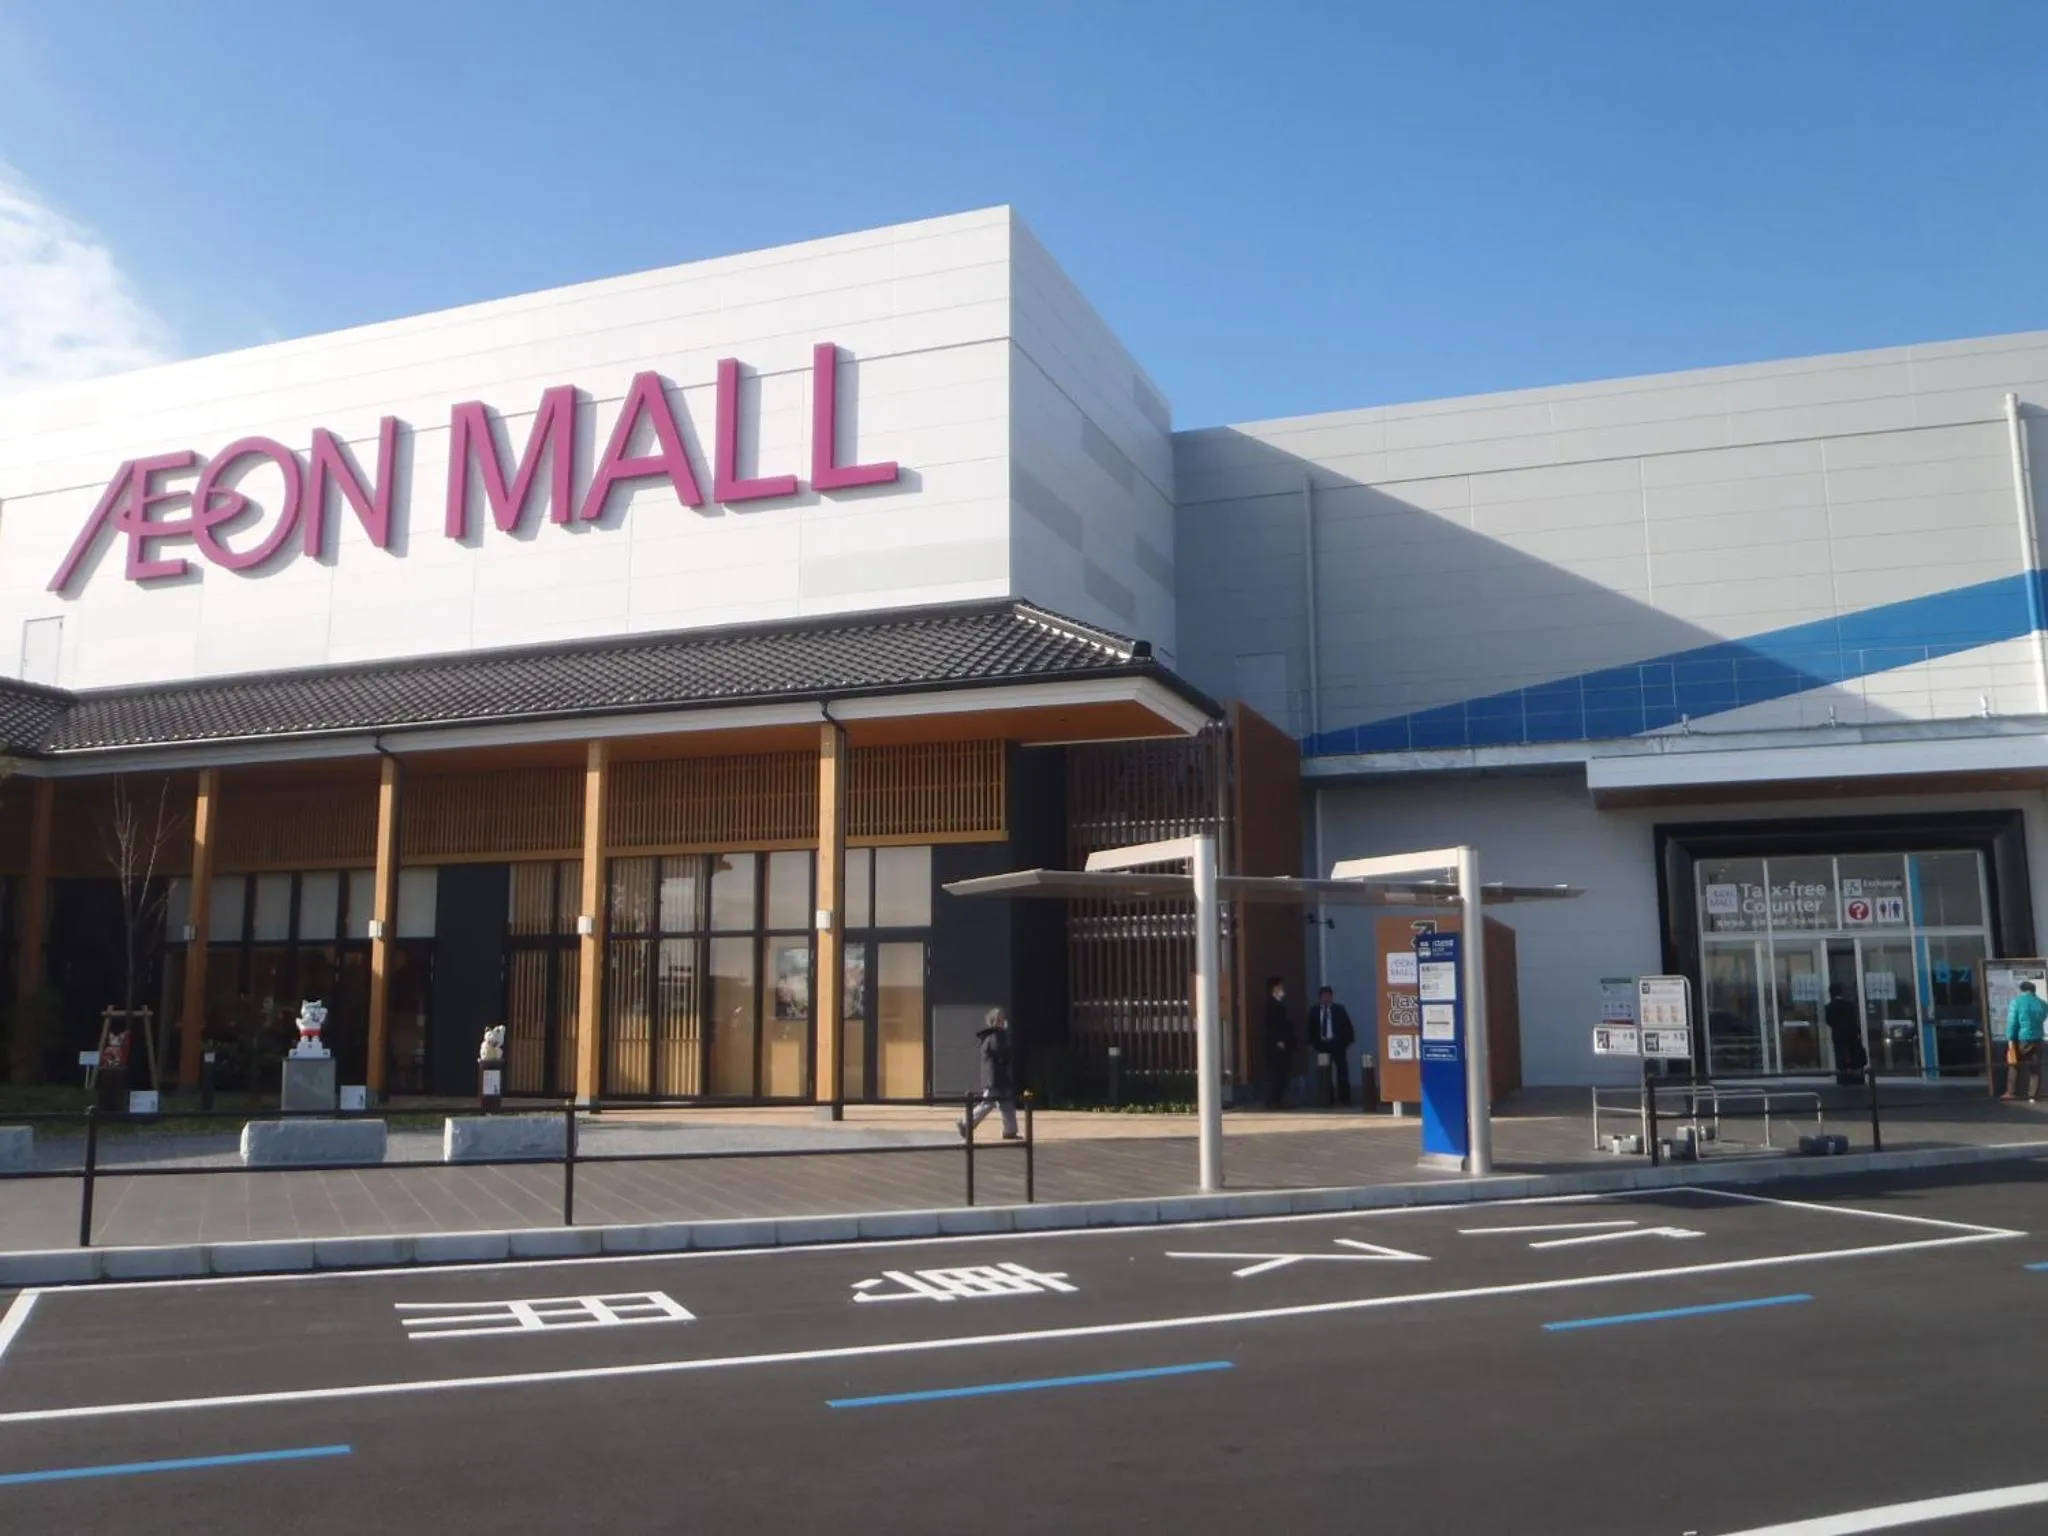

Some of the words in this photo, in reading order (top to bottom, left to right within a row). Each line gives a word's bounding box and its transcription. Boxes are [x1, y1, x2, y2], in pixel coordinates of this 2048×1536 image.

[445, 343, 900, 540] MALL
[1740, 880, 1827, 898] Tax-free
[1743, 899, 1823, 915] Counter
